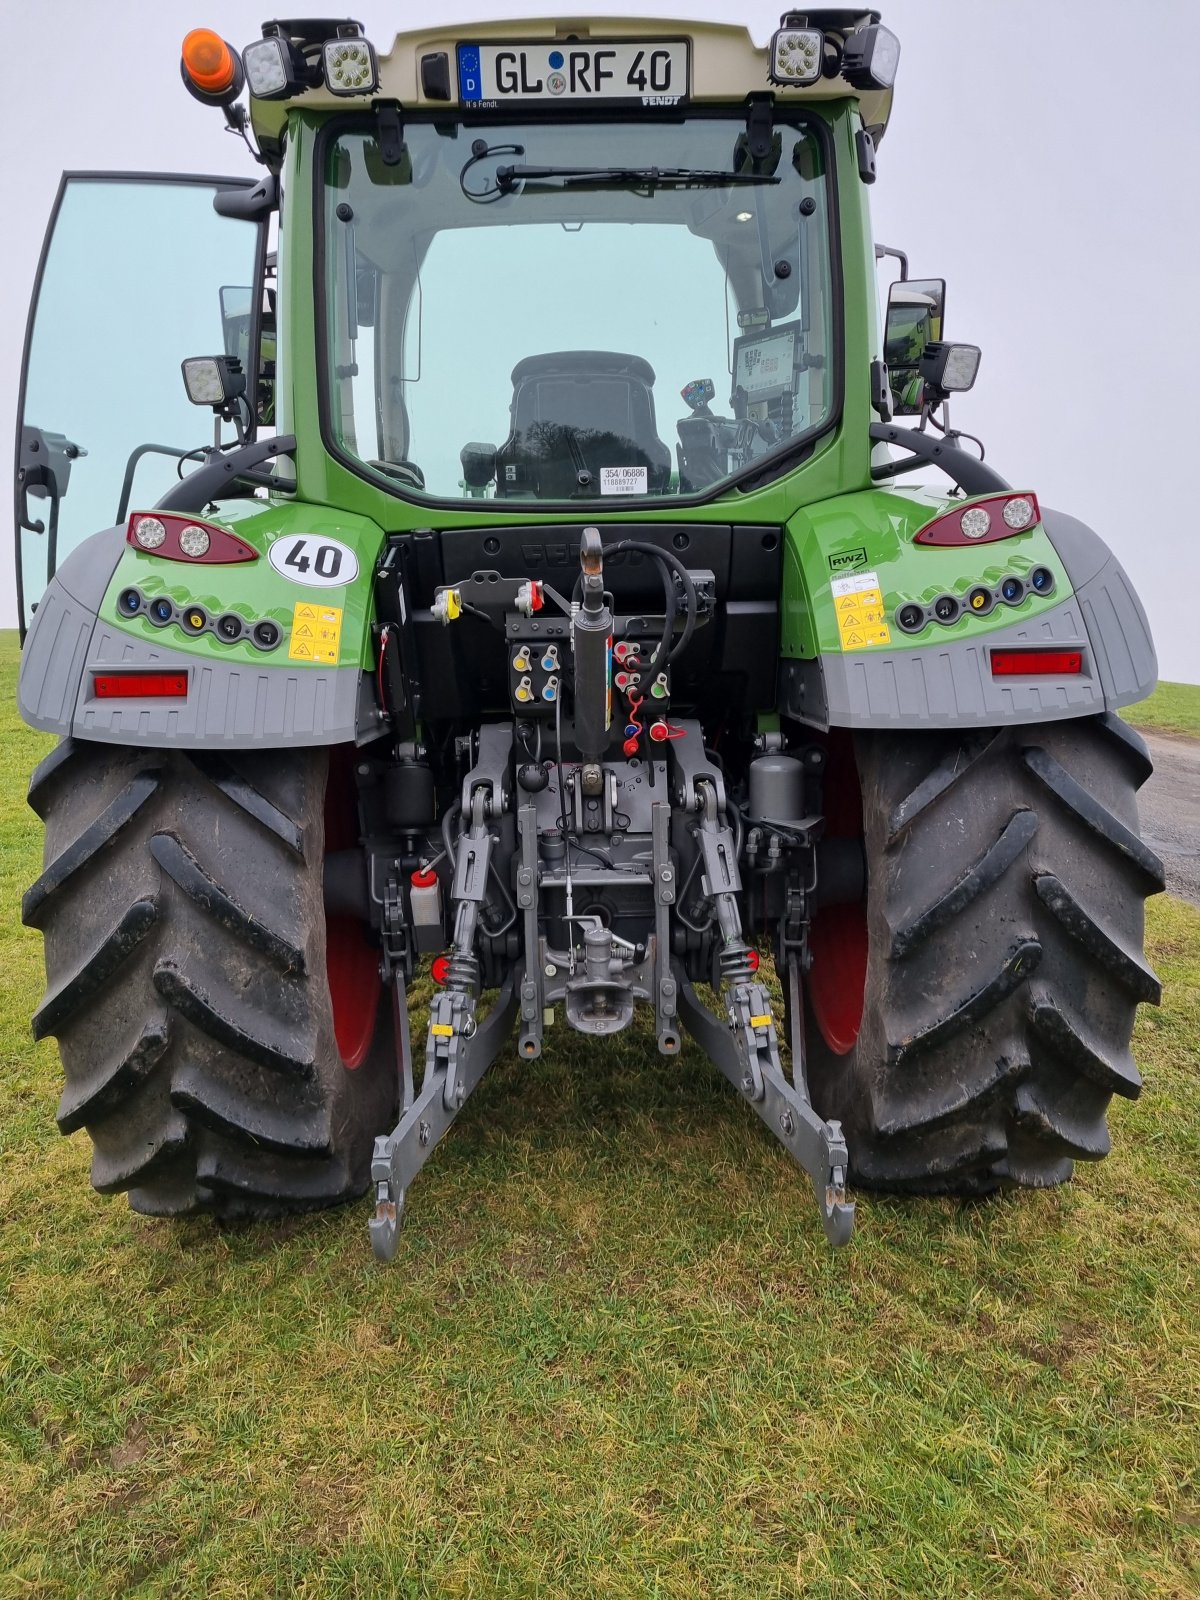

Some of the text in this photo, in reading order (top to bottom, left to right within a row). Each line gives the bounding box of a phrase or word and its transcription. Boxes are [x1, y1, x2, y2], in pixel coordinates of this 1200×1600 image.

[495, 50, 672, 94] GL RF 40
[466, 79, 476, 91] D
[641, 96, 681, 106] FENDT
[284, 539, 343, 579] 40
[832, 553, 864, 566] RWZ
